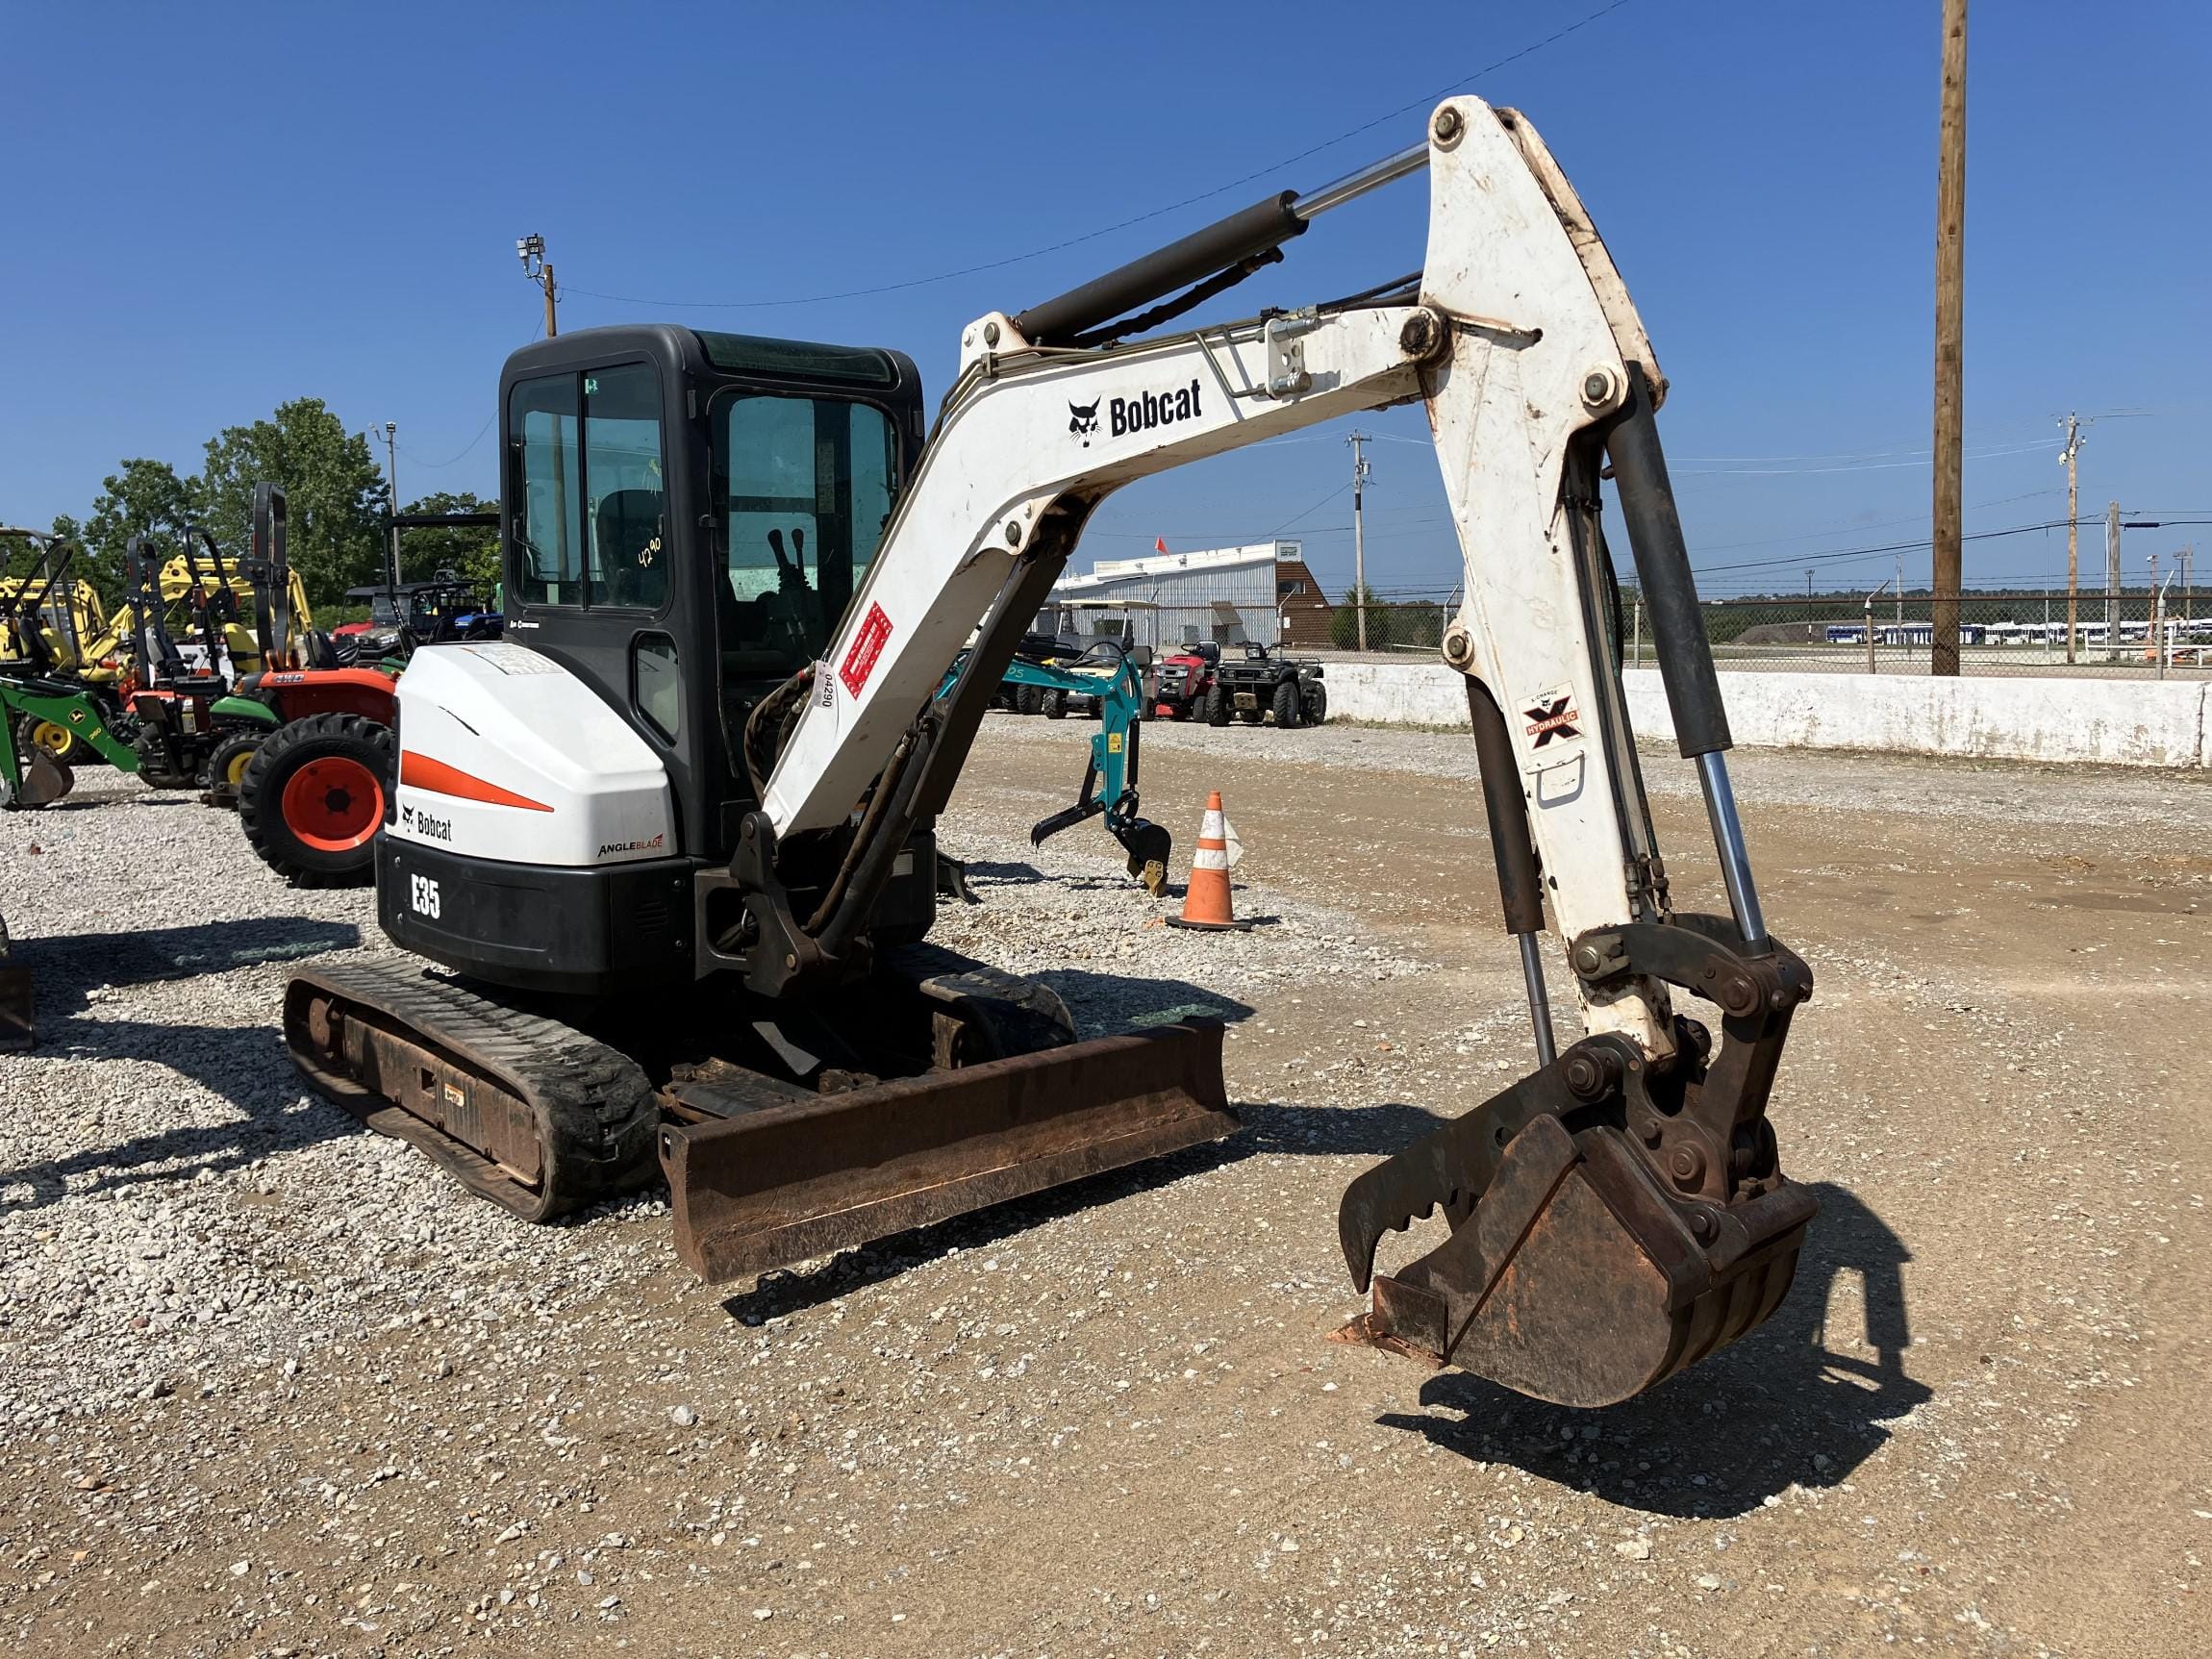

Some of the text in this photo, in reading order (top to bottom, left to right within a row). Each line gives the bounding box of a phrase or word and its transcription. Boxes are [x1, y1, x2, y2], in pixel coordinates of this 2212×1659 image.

[1110, 378, 1201, 438] Bobcat
[639, 538, 661, 567] 4290
[821, 673, 834, 707] 04290
[1527, 712, 1577, 734] HYDRAULIC
[417, 811, 452, 842] Bobcat
[412, 873, 440, 919] E35
